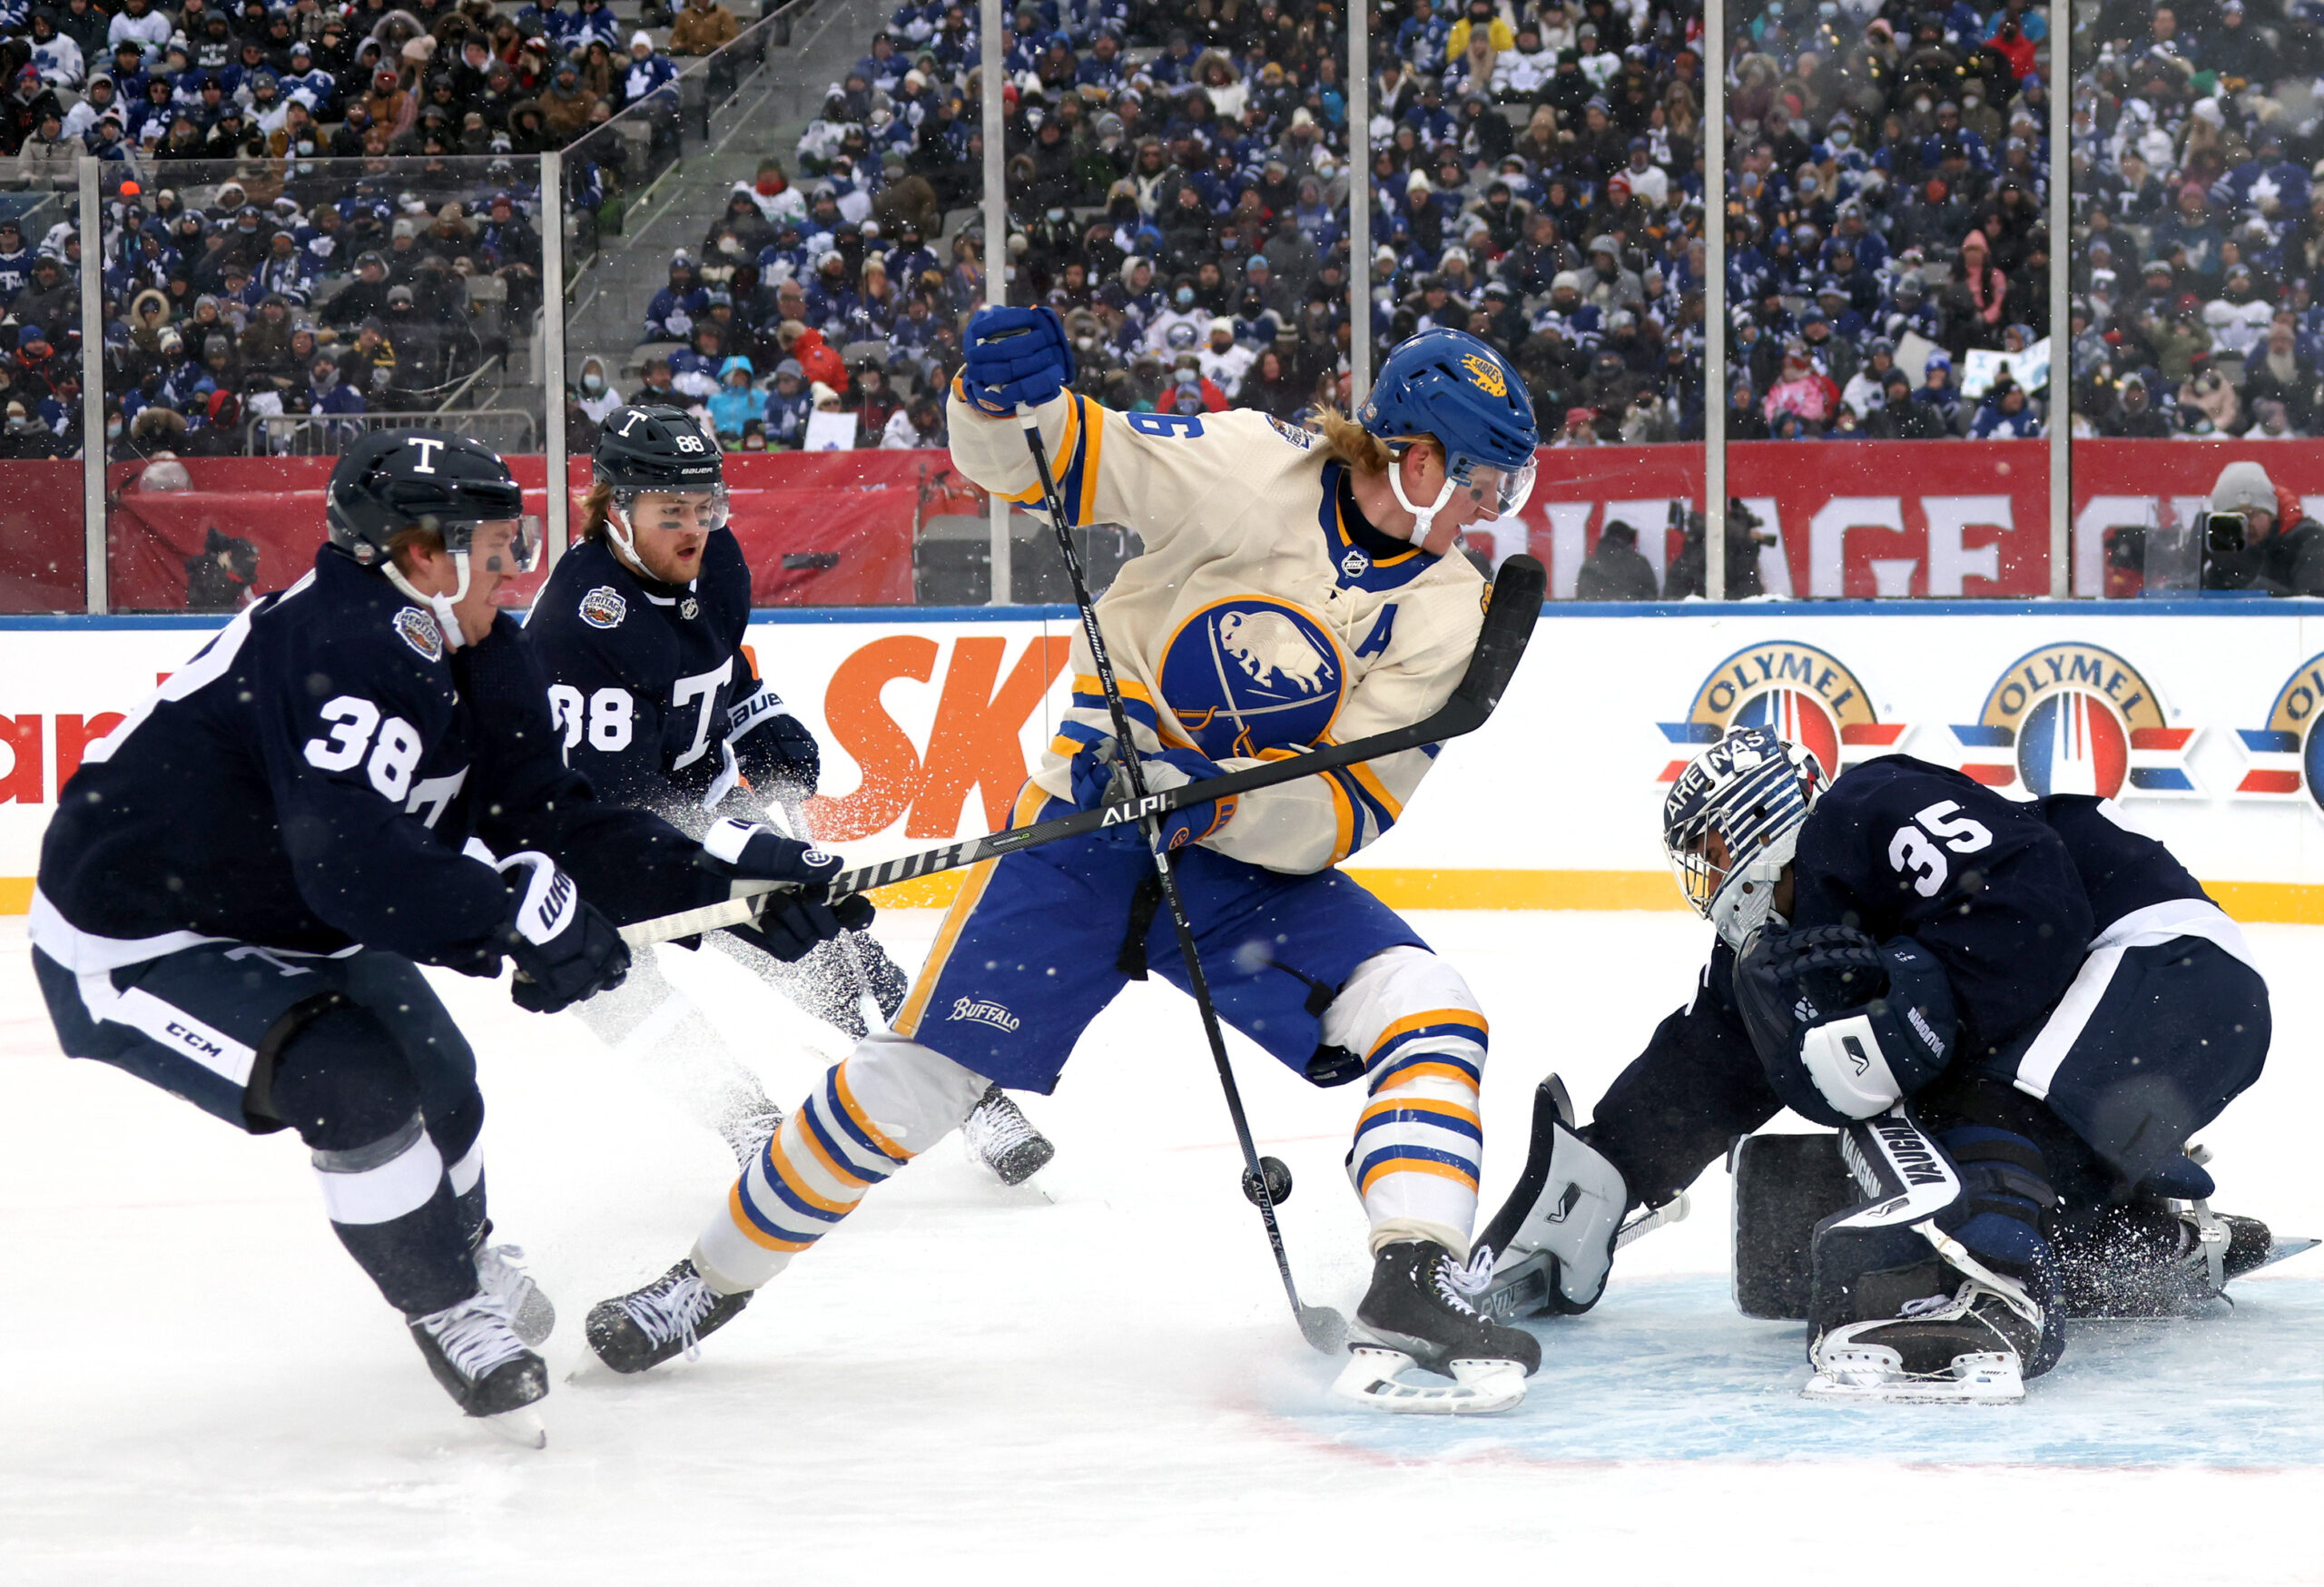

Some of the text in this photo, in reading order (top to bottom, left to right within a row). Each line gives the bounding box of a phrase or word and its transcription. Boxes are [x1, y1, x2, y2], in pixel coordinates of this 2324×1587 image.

[1472, 358, 1502, 383] SABRES
[617, 409, 647, 438] T
[675, 435, 704, 452] 88
[408, 437, 444, 474] T
[584, 596, 623, 616] HERITAGE
[1354, 604, 1399, 659] A
[1708, 653, 1854, 718] OLYMEL
[1999, 654, 2144, 722] OLYMEL
[673, 655, 734, 772] T
[303, 695, 423, 803] 38
[1888, 800, 1993, 897] 35
[165, 1020, 223, 1058] CCM
[1907, 1007, 1945, 1060] VAUGHN
[1842, 1128, 1881, 1199] VAUGHN
[1253, 1180, 1275, 1227] ALPHA
[1268, 1231, 1284, 1250] LX
